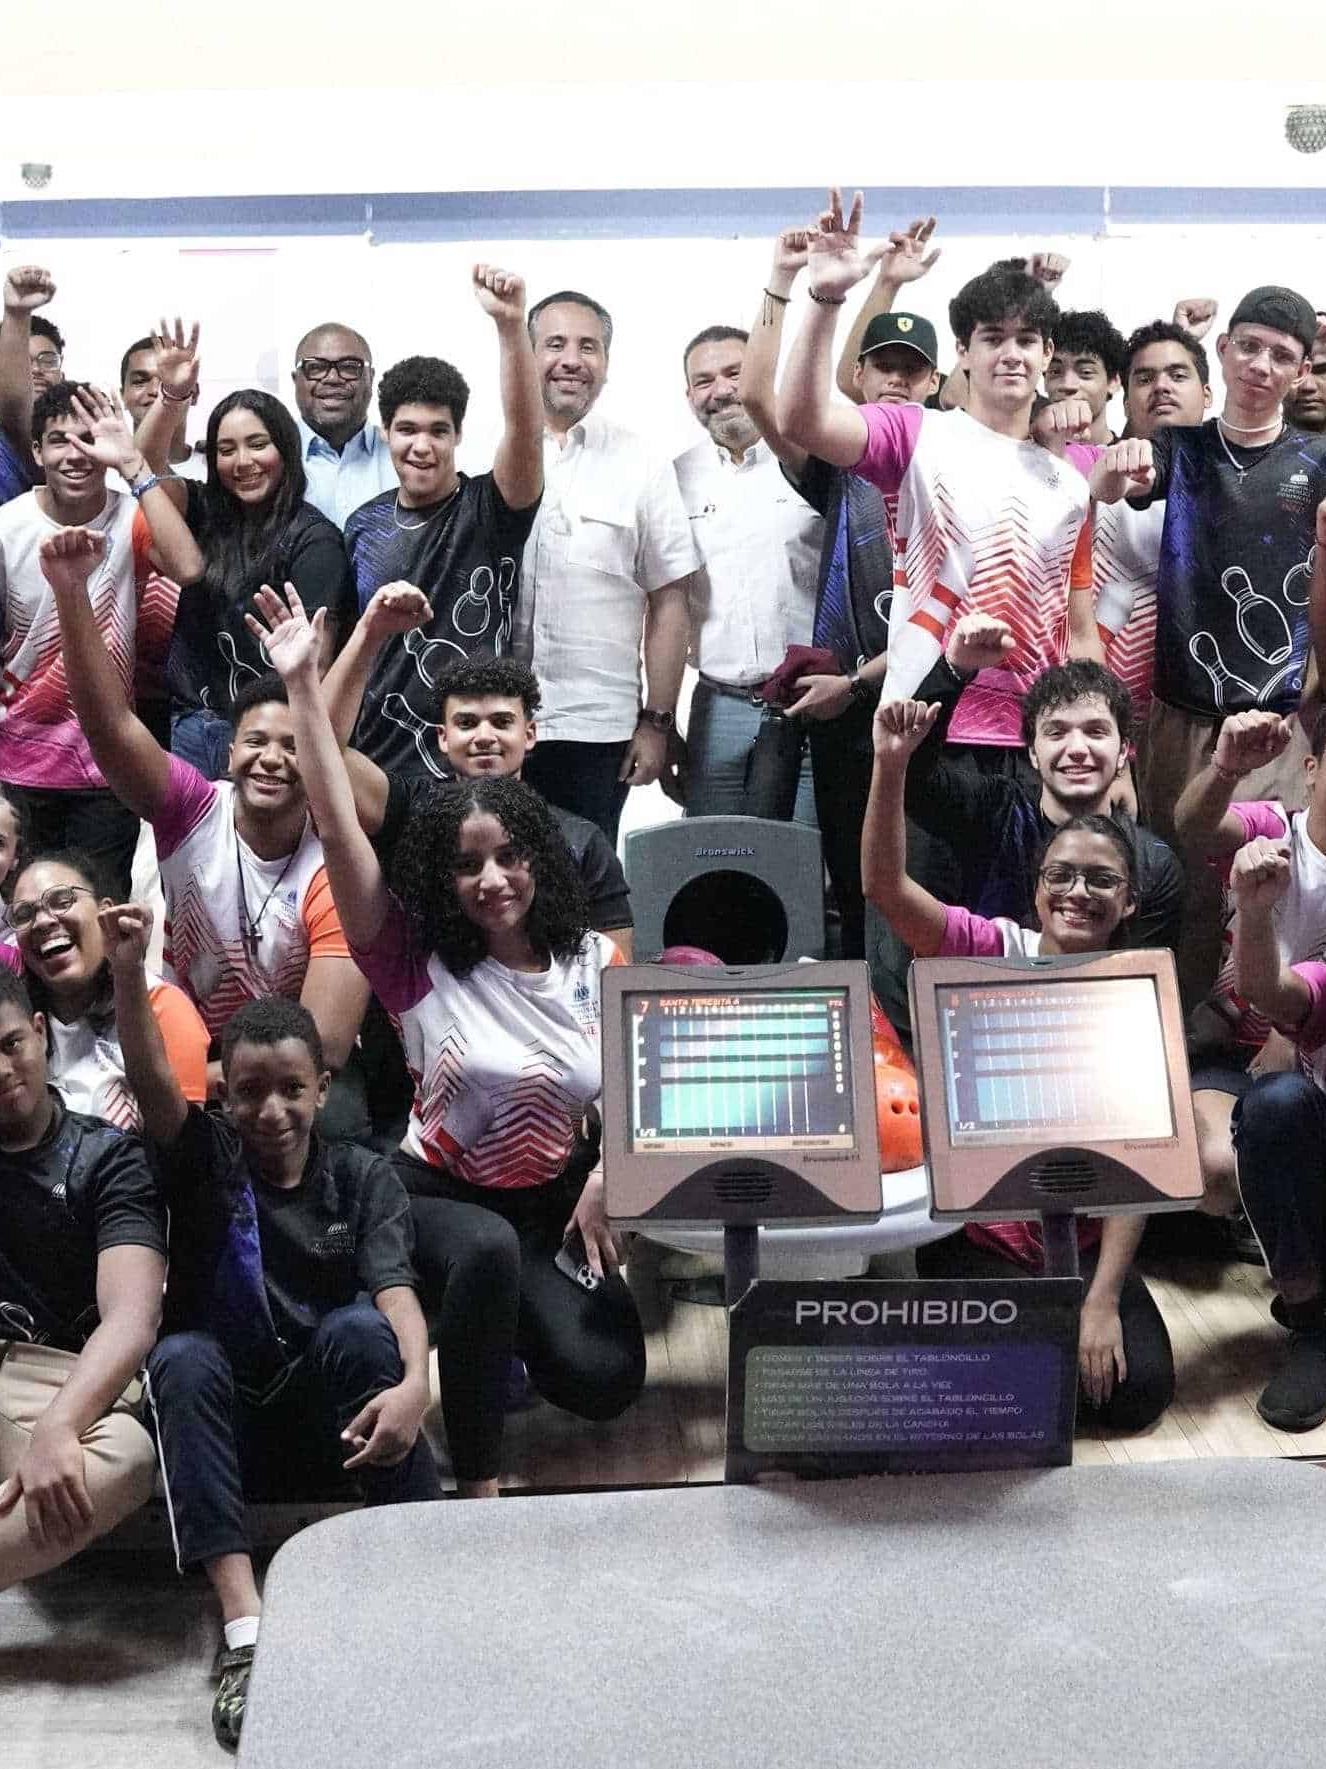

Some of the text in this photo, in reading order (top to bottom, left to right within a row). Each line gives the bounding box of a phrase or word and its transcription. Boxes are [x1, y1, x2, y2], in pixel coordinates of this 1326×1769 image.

[694, 847, 755, 857] Brunswick
[641, 1000, 649, 1014] 7
[795, 1299, 1018, 1326] PROHIBIDO
[914, 1353, 991, 1361] TABLONCILLO
[939, 1393, 1015, 1402] TABLONCILLO
